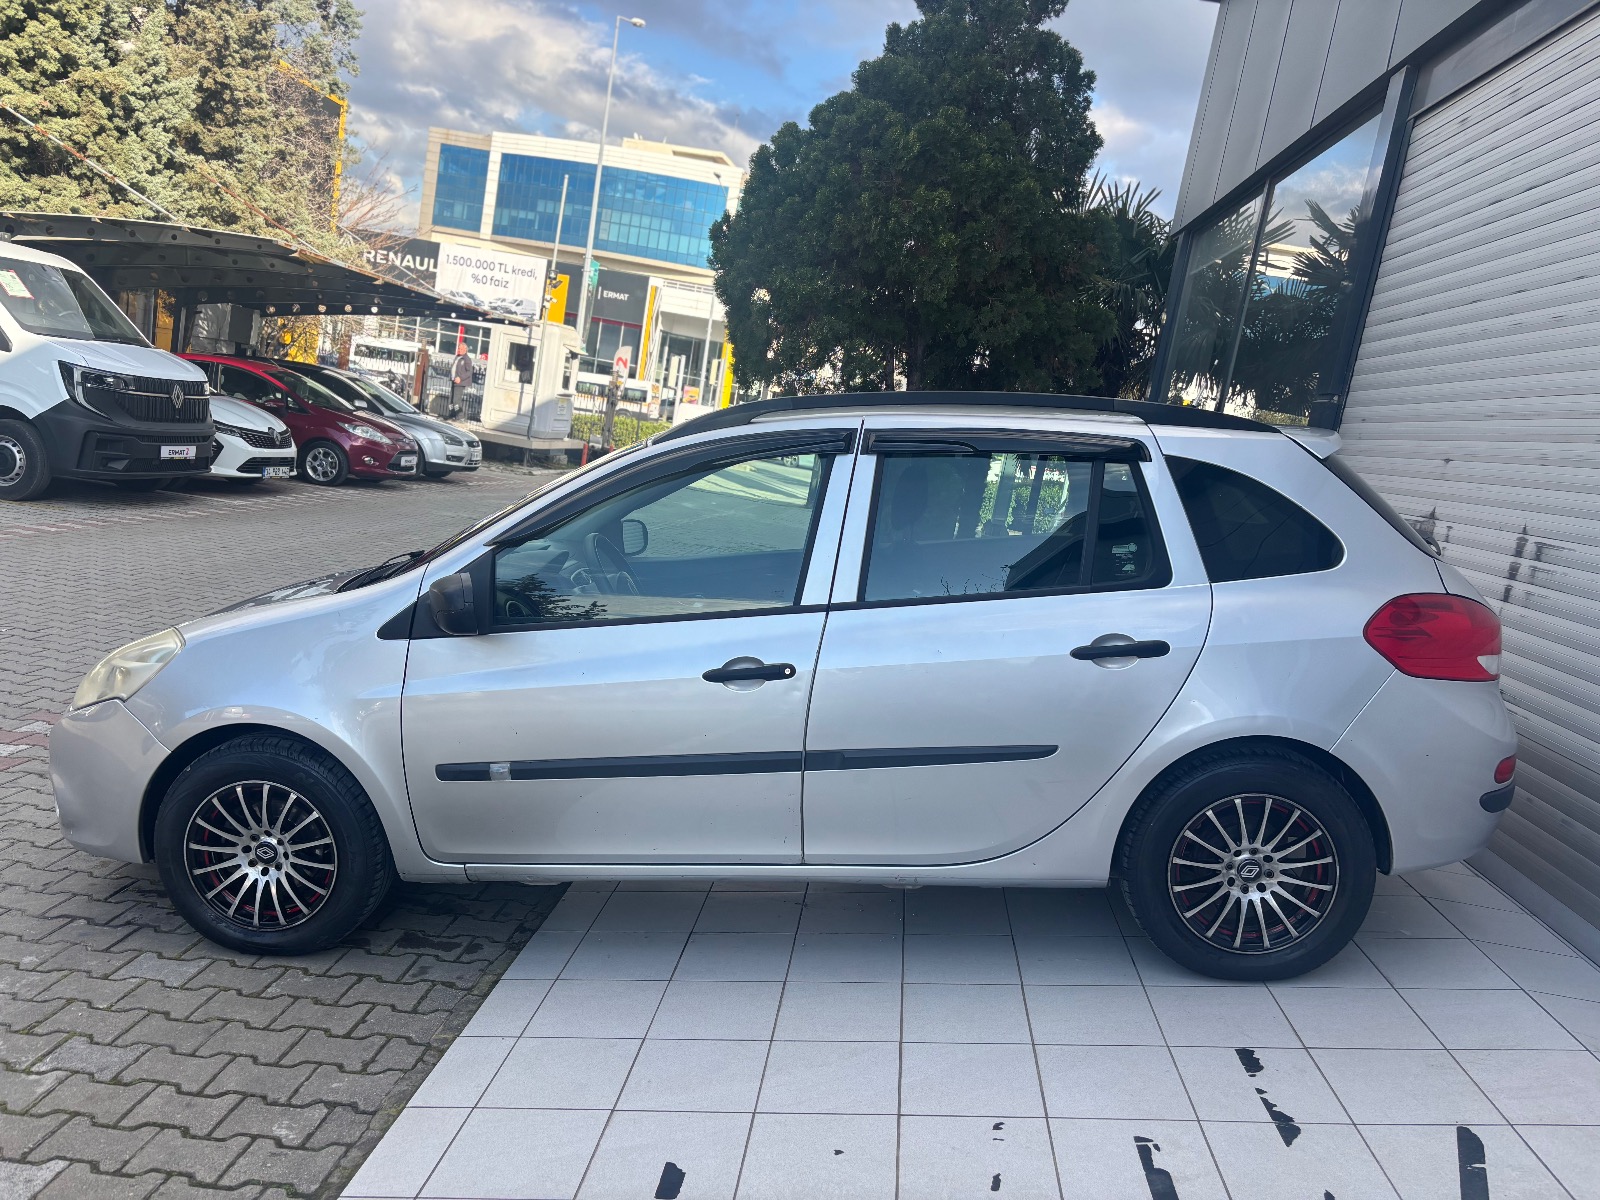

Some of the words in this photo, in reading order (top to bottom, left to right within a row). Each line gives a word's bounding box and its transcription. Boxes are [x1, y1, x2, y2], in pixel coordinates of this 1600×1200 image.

[363, 249, 438, 272] RENAUL
[446, 254, 496, 271] 1.500.000
[497, 262, 510, 274] TL
[511, 265, 538, 280] kredi,
[471, 273, 488, 285] %0
[489, 276, 509, 288] faiz
[603, 290, 630, 301] ERMAT
